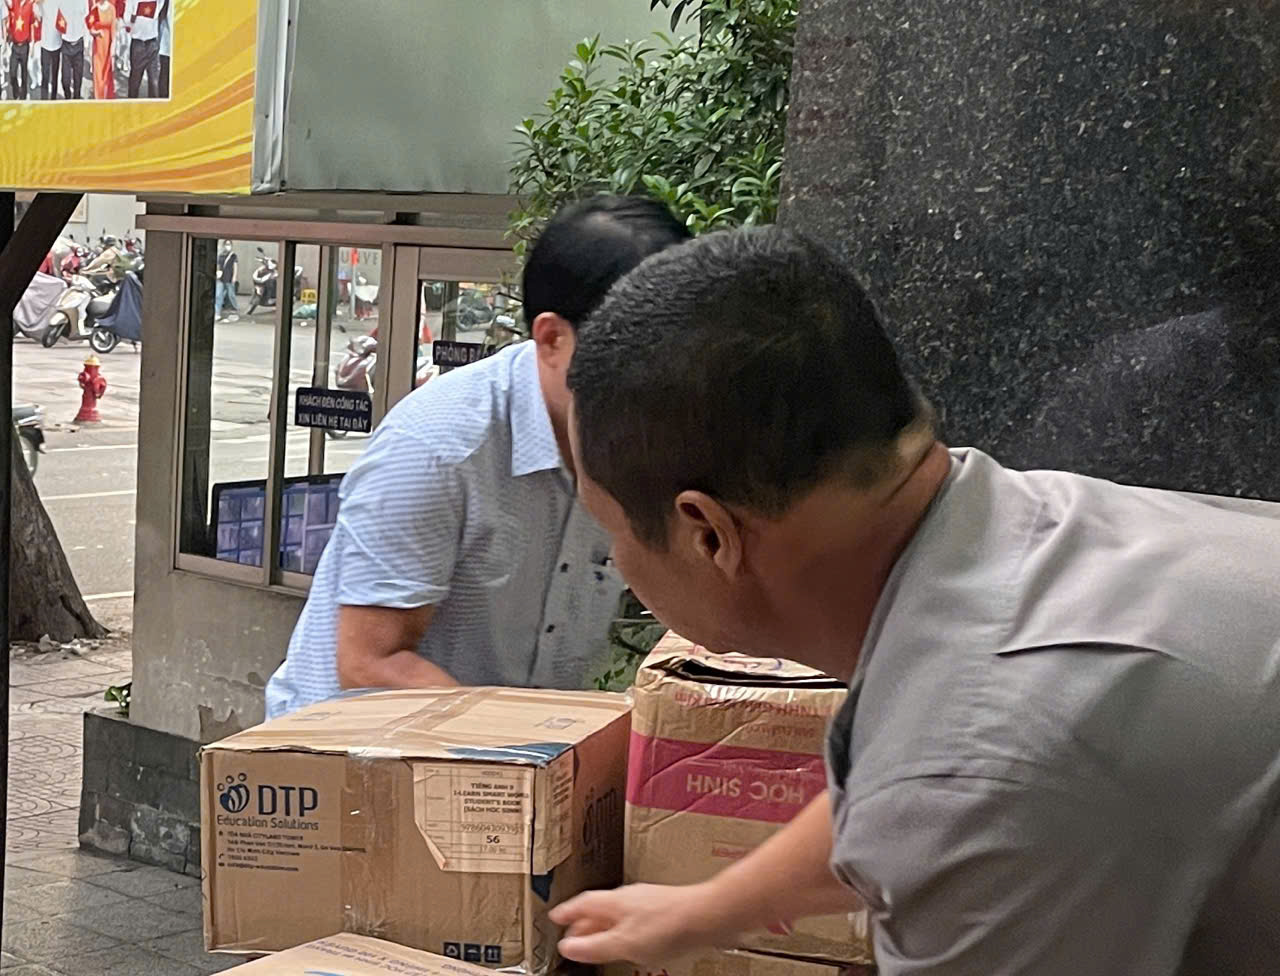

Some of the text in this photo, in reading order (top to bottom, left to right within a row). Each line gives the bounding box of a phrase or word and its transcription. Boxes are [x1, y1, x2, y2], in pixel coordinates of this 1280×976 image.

[686, 773, 741, 798] SINH
[258, 784, 318, 817] DTP
[217, 814, 319, 831] Education Solutions
[486, 834, 500, 844] 56
